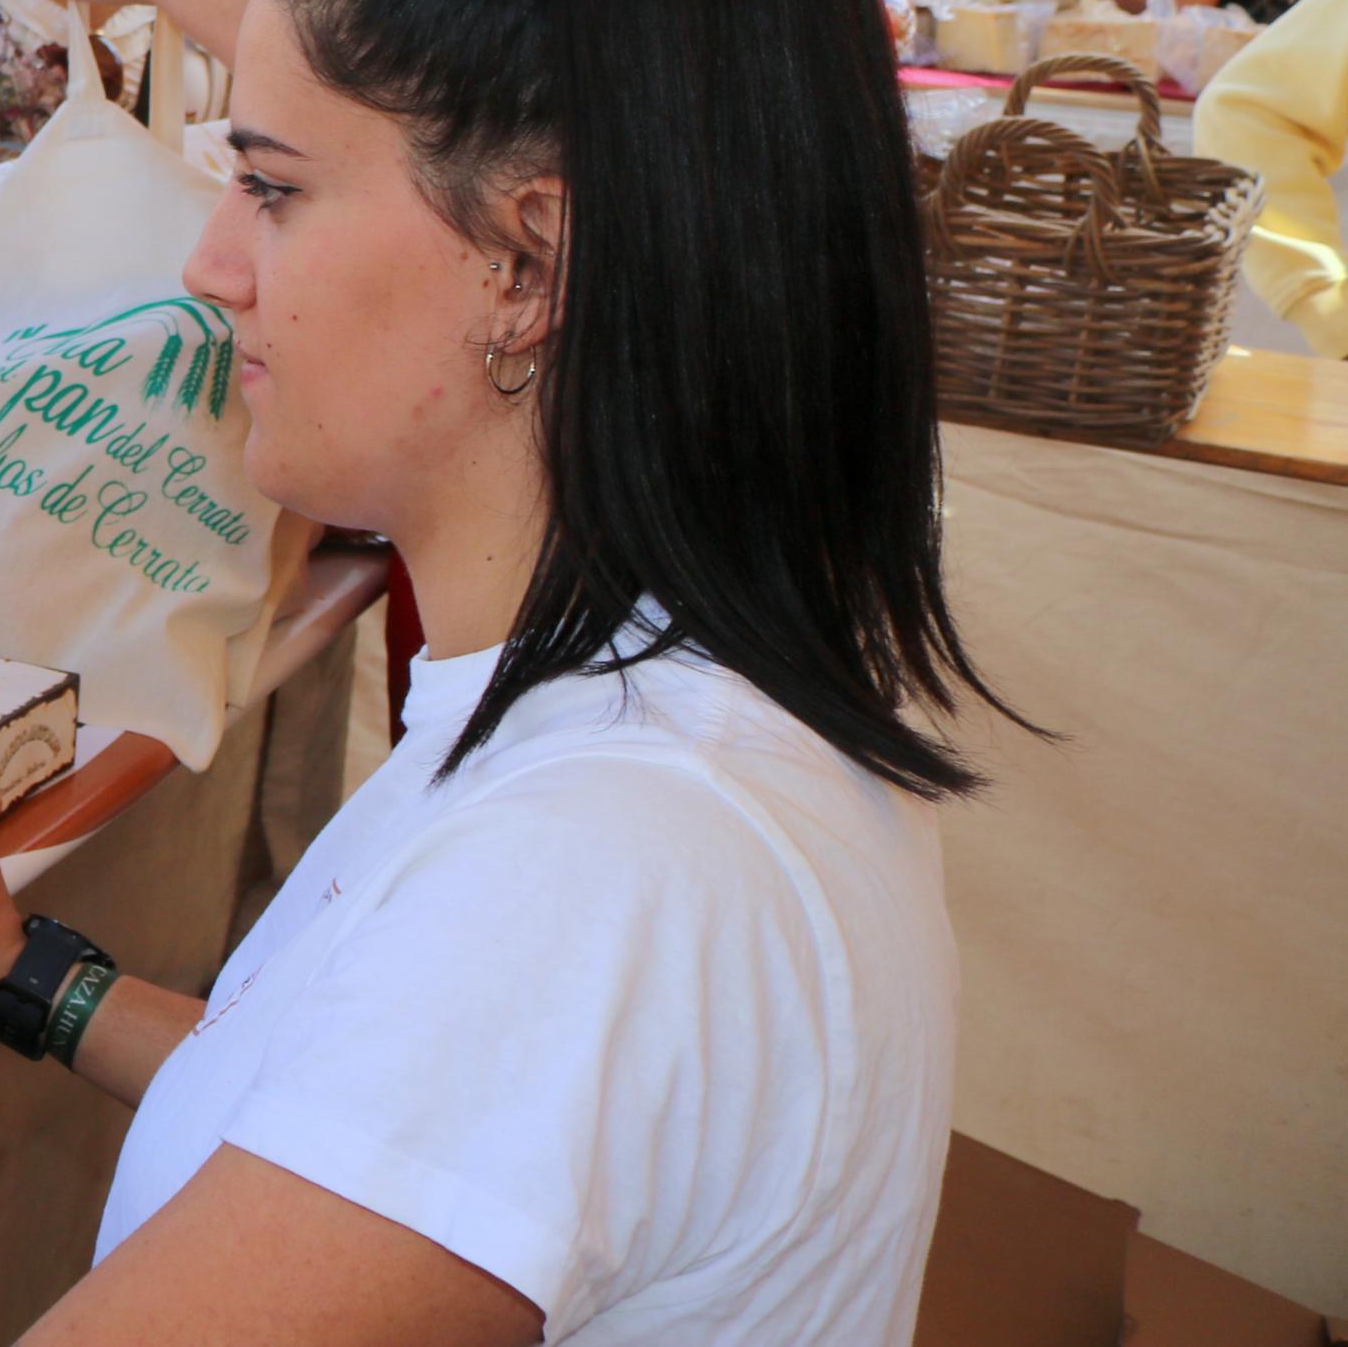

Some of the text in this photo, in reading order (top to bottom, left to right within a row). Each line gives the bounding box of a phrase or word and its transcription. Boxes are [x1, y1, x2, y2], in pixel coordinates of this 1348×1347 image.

[40, 464, 95, 524] de
[91, 480, 210, 593] Cerrato
[105, 422, 170, 474] del
[161, 446, 251, 546] Cerrato
